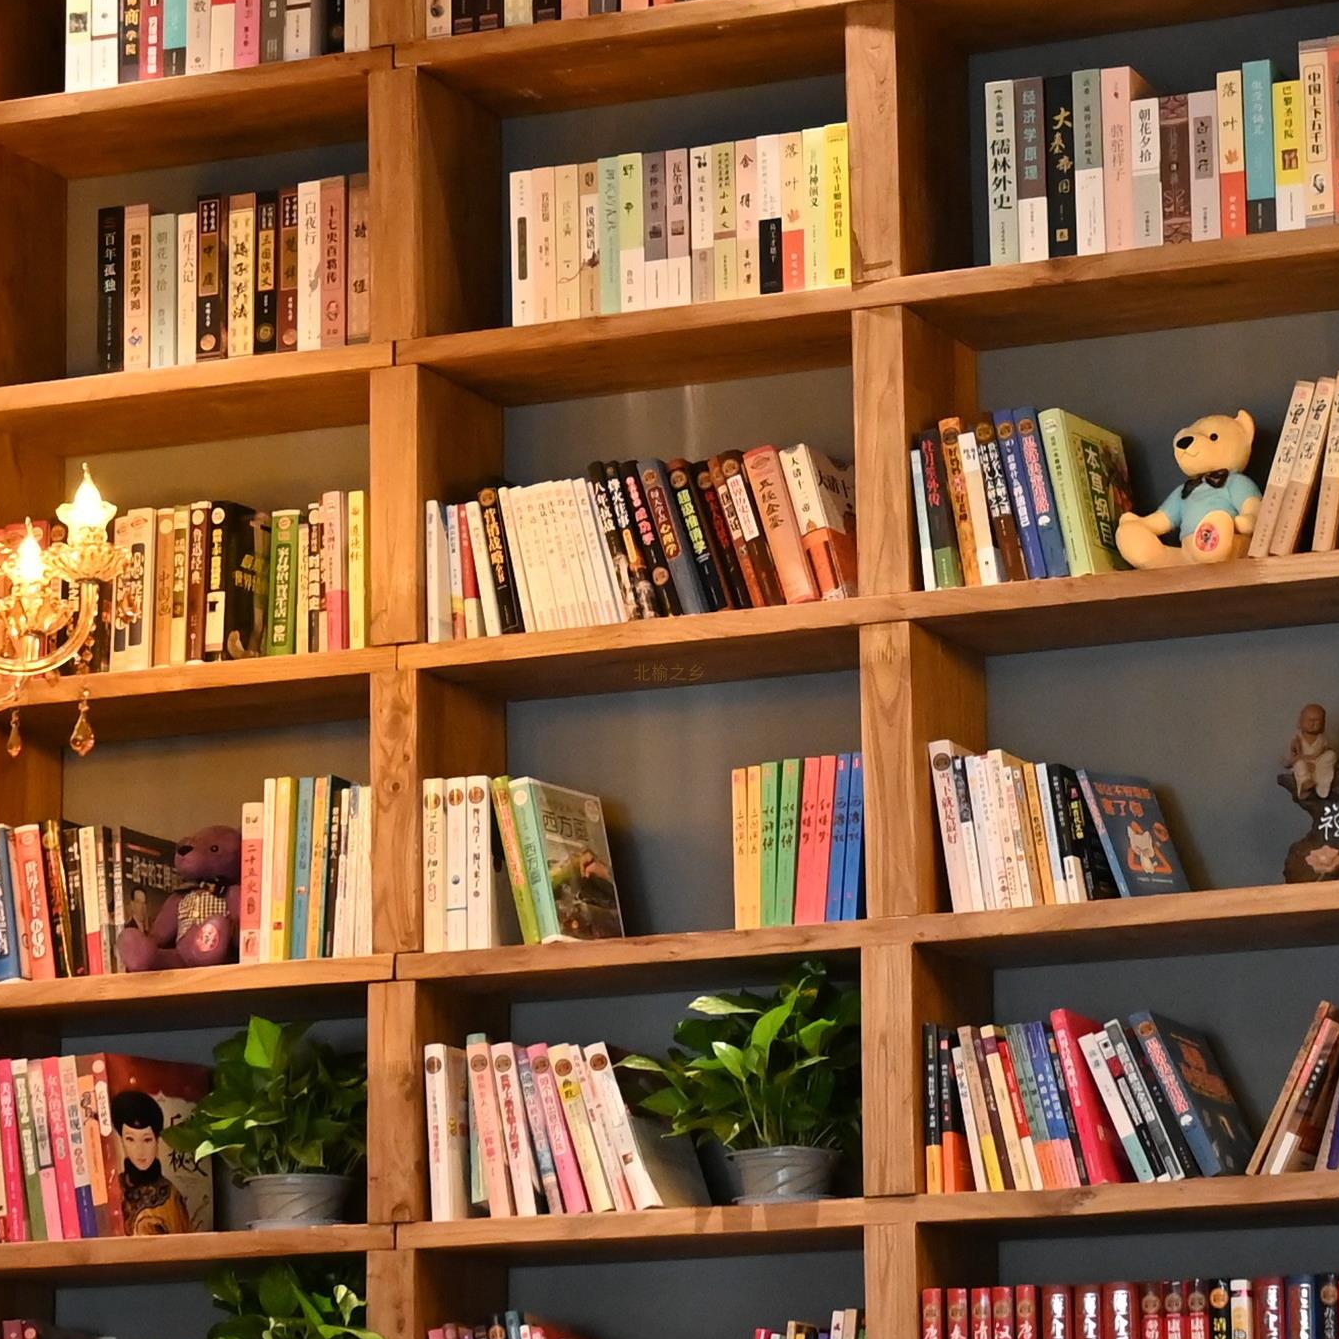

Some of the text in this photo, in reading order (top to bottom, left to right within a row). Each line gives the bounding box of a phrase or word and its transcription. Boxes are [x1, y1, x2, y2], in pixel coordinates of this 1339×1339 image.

[1222, 82, 1238, 130] 落叶
[1282, 85, 1294, 140] 巴黎圣母院
[1307, 72, 1323, 155] 中国上下五千年
[1022, 89, 1038, 181] 经济学原理
[1049, 106, 1074, 194] 大秦帝国
[1110, 124, 1124, 181] 骆驼祥子
[1138, 108, 1152, 163] 朝花夕拾
[672, 163, 683, 206] 瓦尔登湖
[739, 154, 753, 208] 舍得
[784, 143, 799, 190] 落叶
[990, 137, 1013, 211] 儒林外史
[304, 199, 316, 245] 白夜行
[103, 232, 117, 293] 百年孤独
[156, 232, 168, 292] 朝花夕拾
[181, 230, 194, 284] 浮生六记
[261, 234, 272, 287] 三国演义
[1083, 443, 1117, 548] 本草纲目
